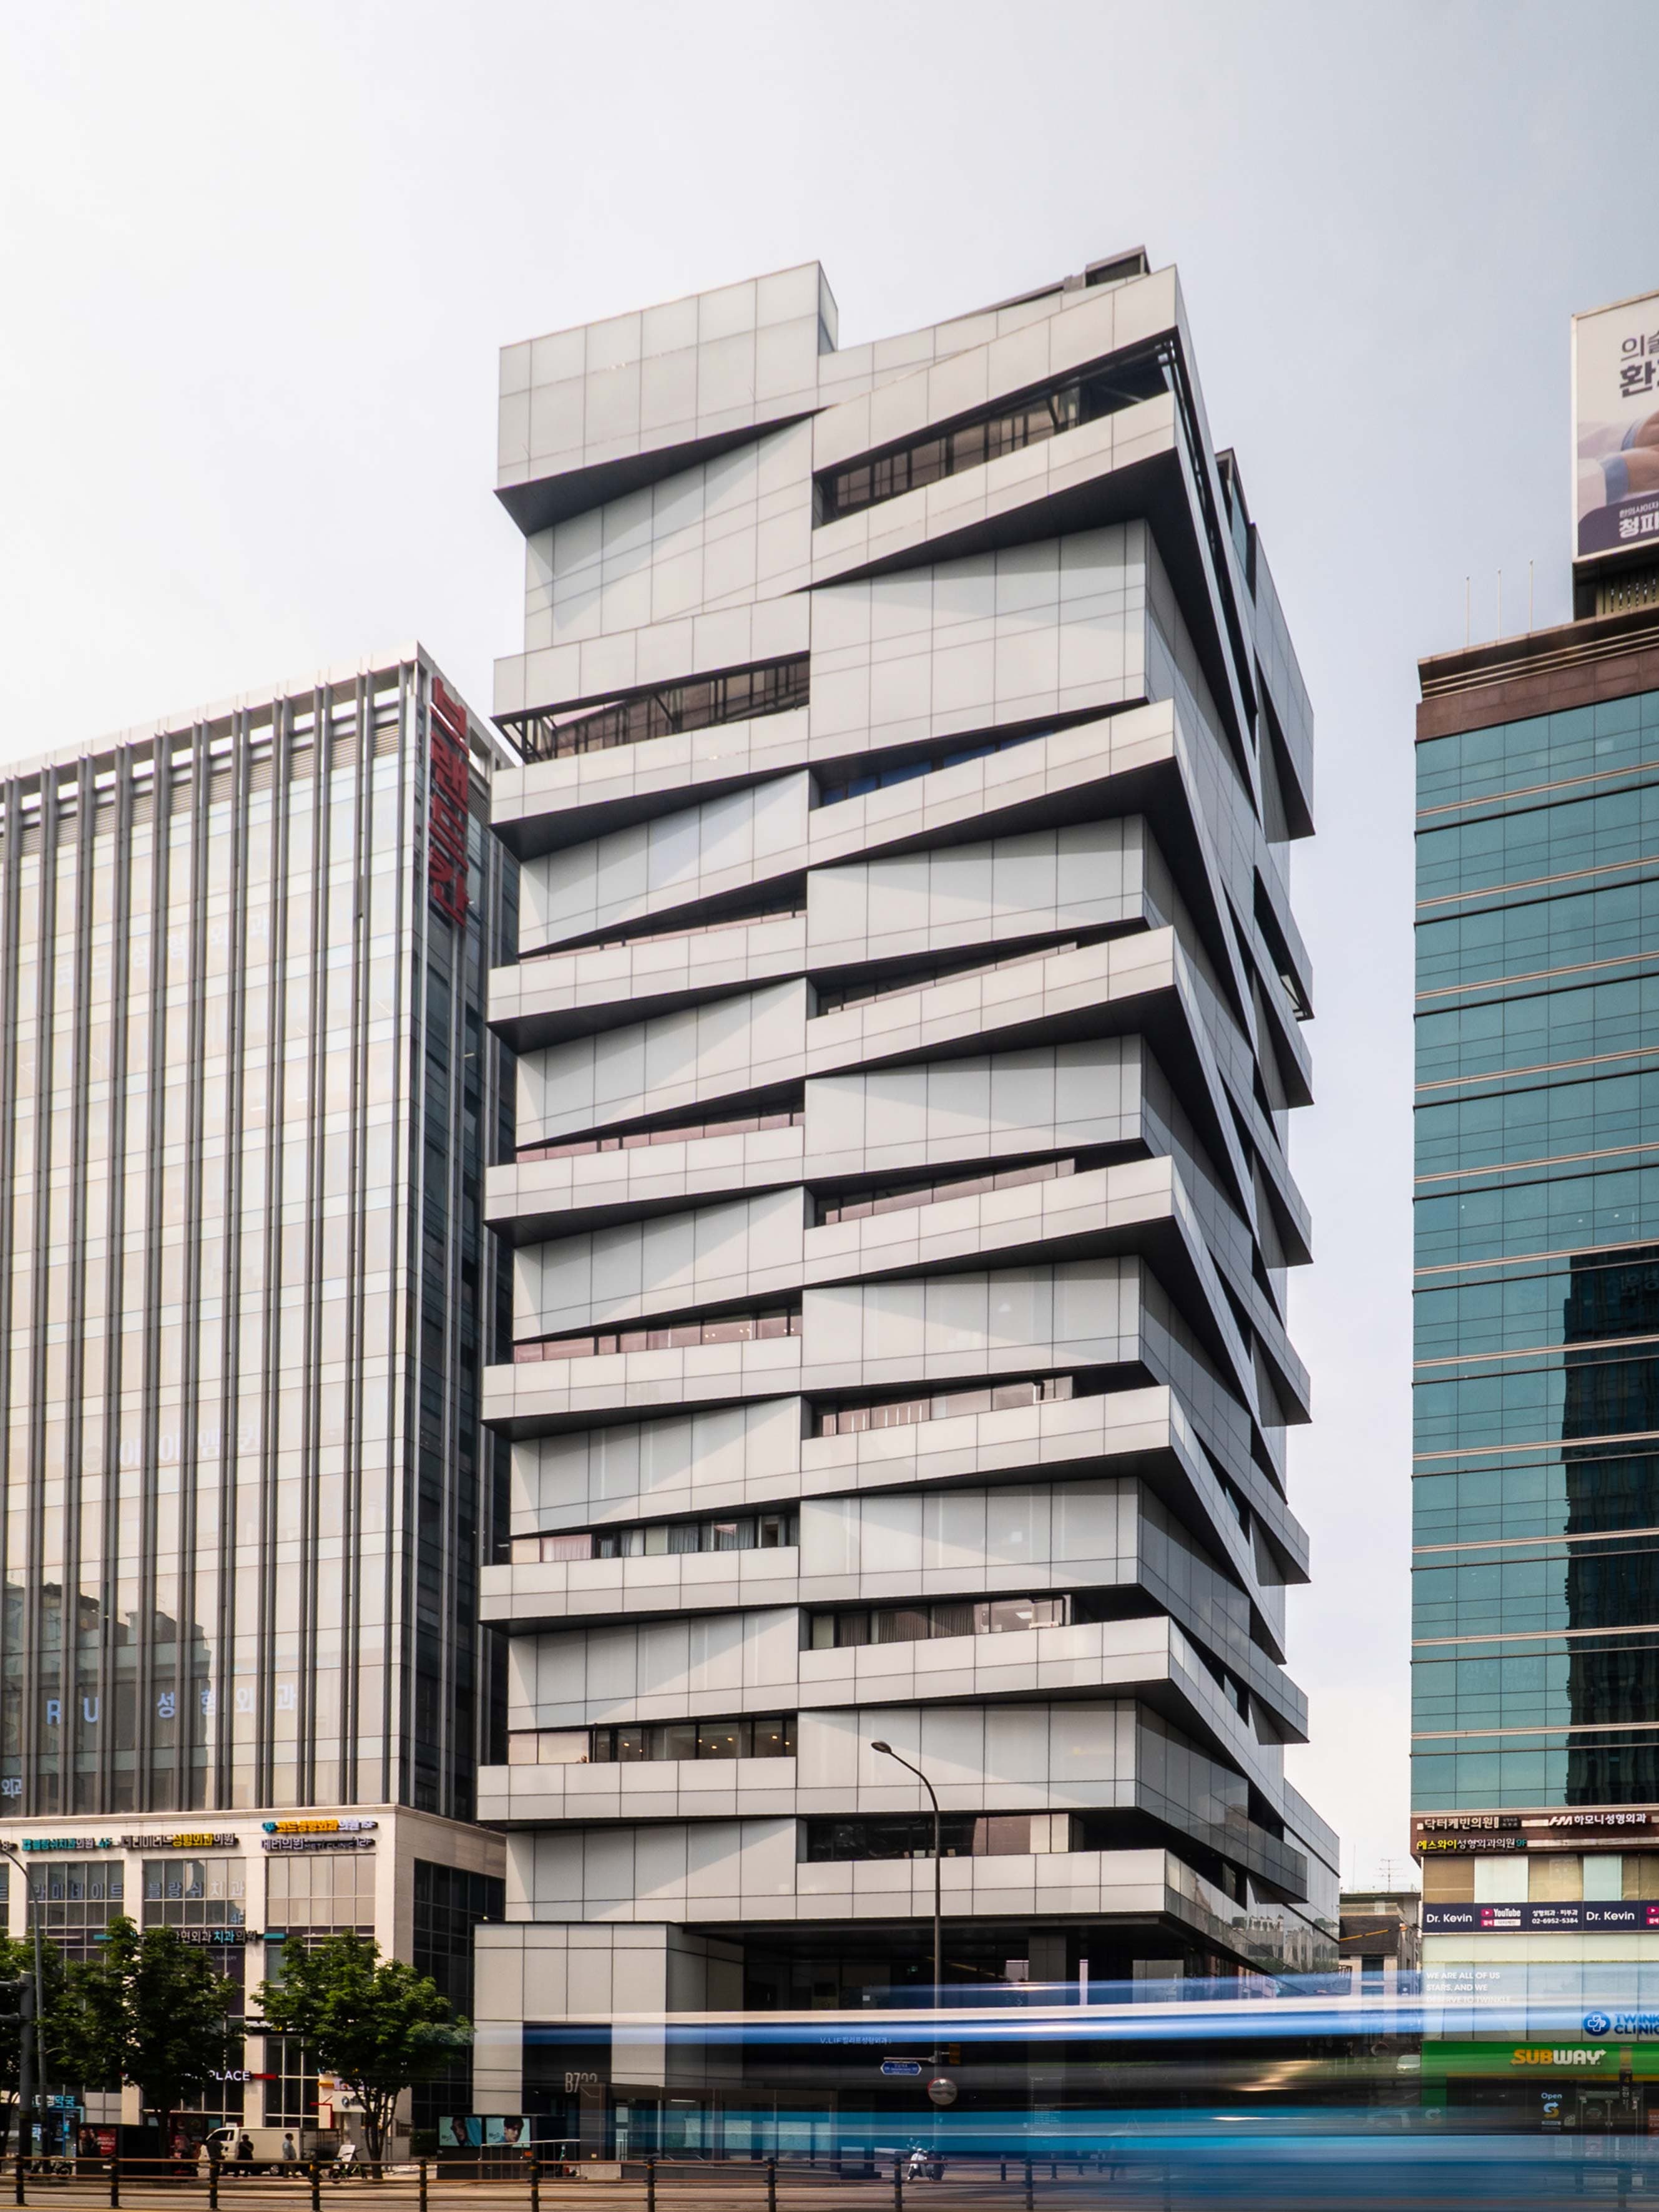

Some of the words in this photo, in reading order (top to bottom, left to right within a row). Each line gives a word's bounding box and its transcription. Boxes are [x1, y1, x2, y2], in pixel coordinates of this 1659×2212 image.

[1620, 360, 1659, 398] 환
[1424, 1816, 1494, 1830] 닥터케빈의원
[1574, 1813, 1647, 1825] 하모니성형외과
[149, 1881, 245, 1899] 블랑쉬치과
[1426, 1914, 1441, 1922] Dr.
[1443, 1913, 1472, 1922] Kevin
[1493, 1908, 1521, 1917] YouTube
[1586, 1912, 1601, 1921] Dr.
[1604, 1911, 1635, 1921] Kevin
[1510, 2048, 1607, 2065] SUBWAY
[1540, 2092, 1562, 2100] Open
